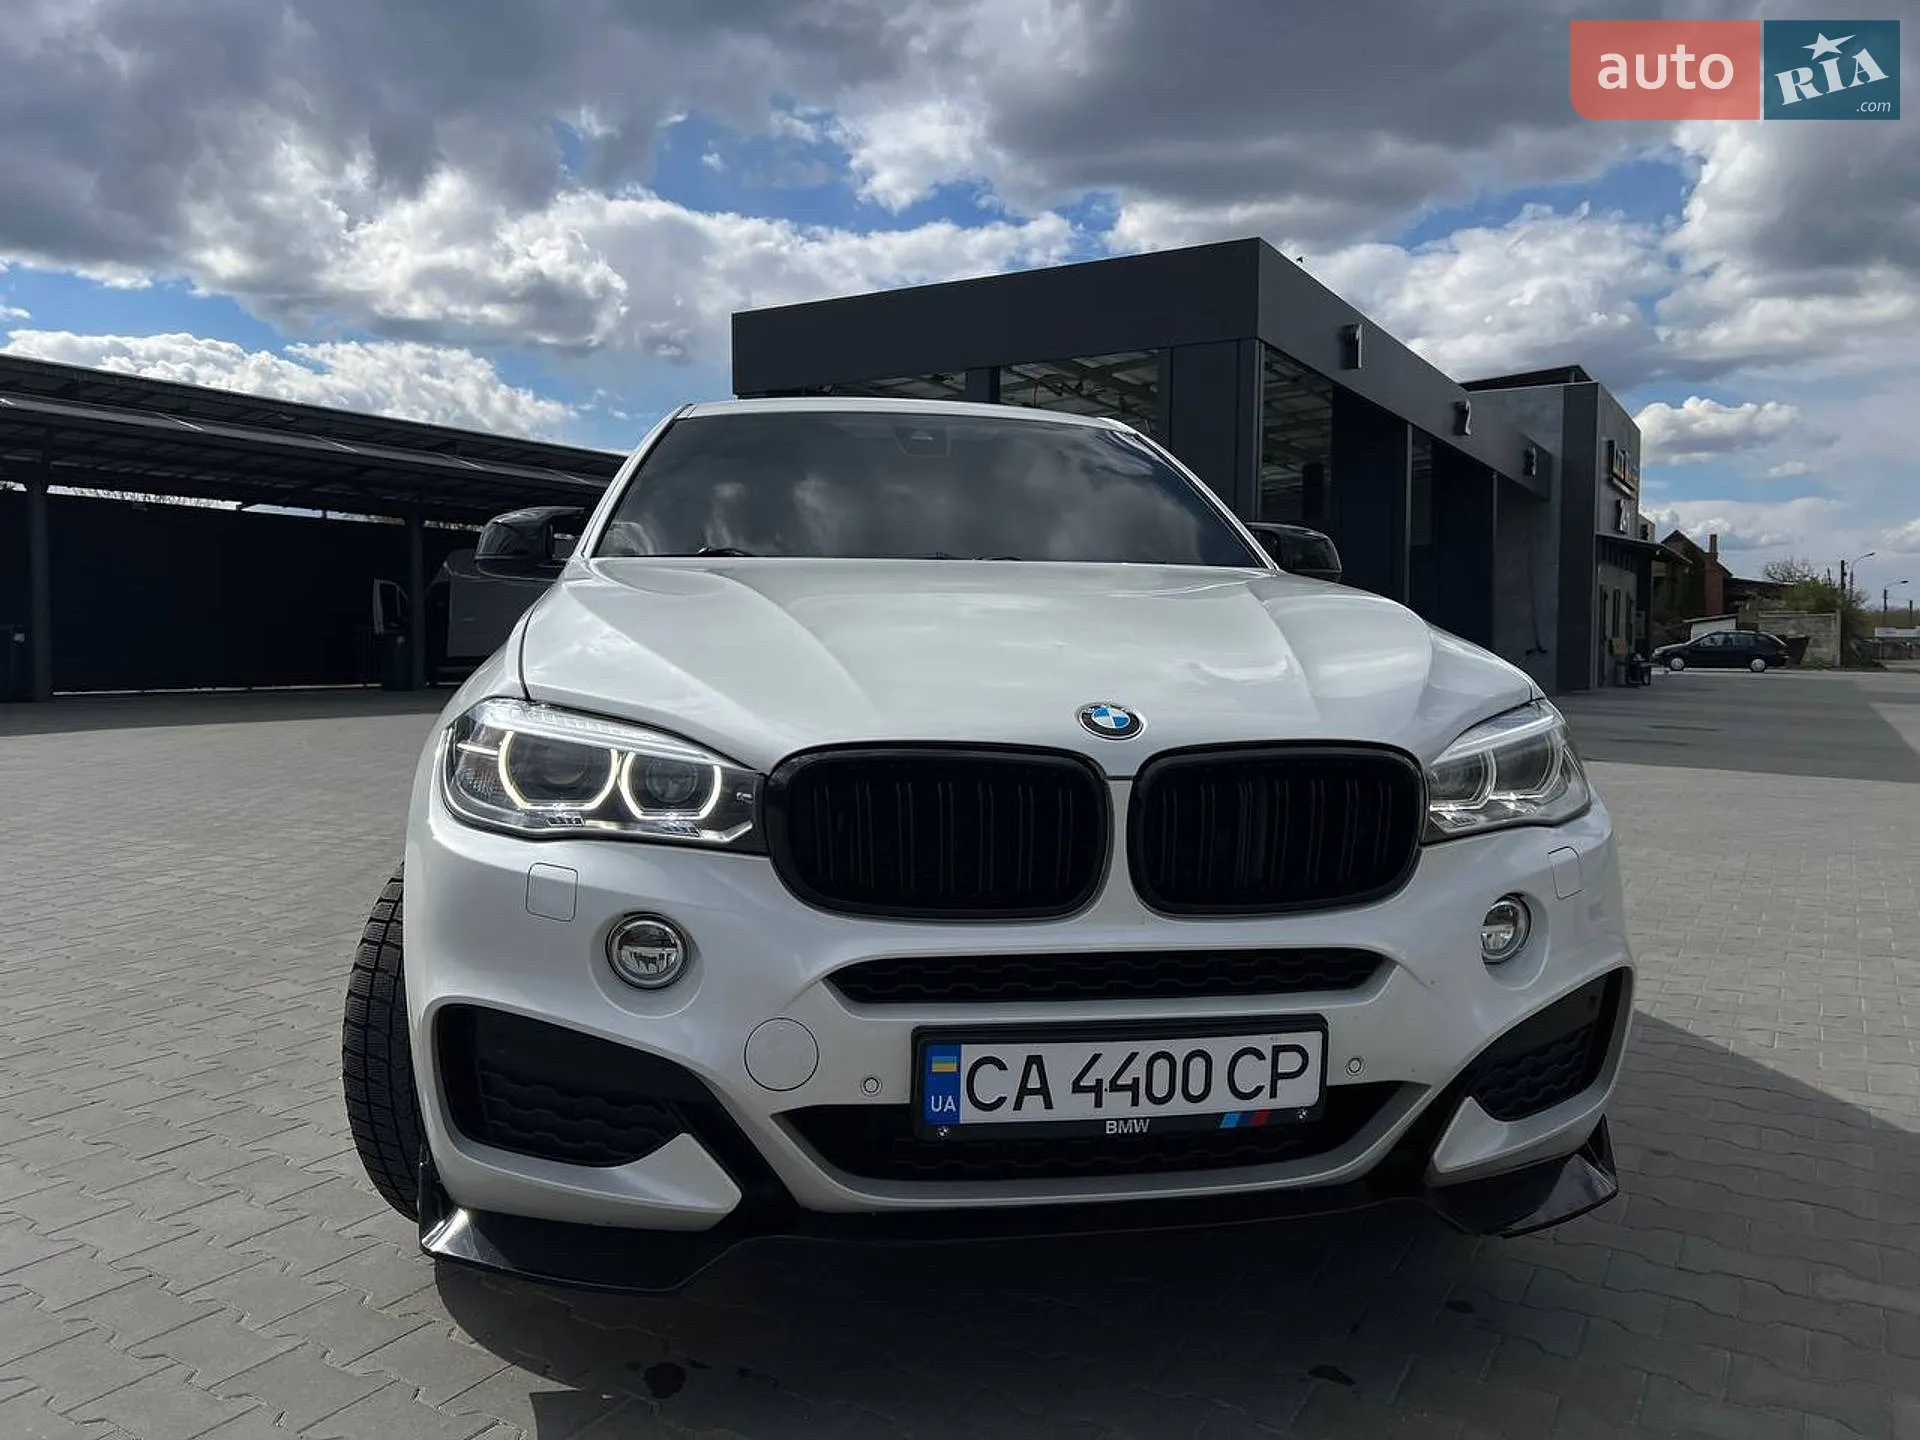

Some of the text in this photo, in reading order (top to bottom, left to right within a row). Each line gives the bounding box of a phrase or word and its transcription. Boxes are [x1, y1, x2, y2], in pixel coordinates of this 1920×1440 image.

[966, 1043, 1310, 1112] CA 4400 CP
[931, 1096, 956, 1113] UA
[1105, 1118, 1150, 1134] BMW
